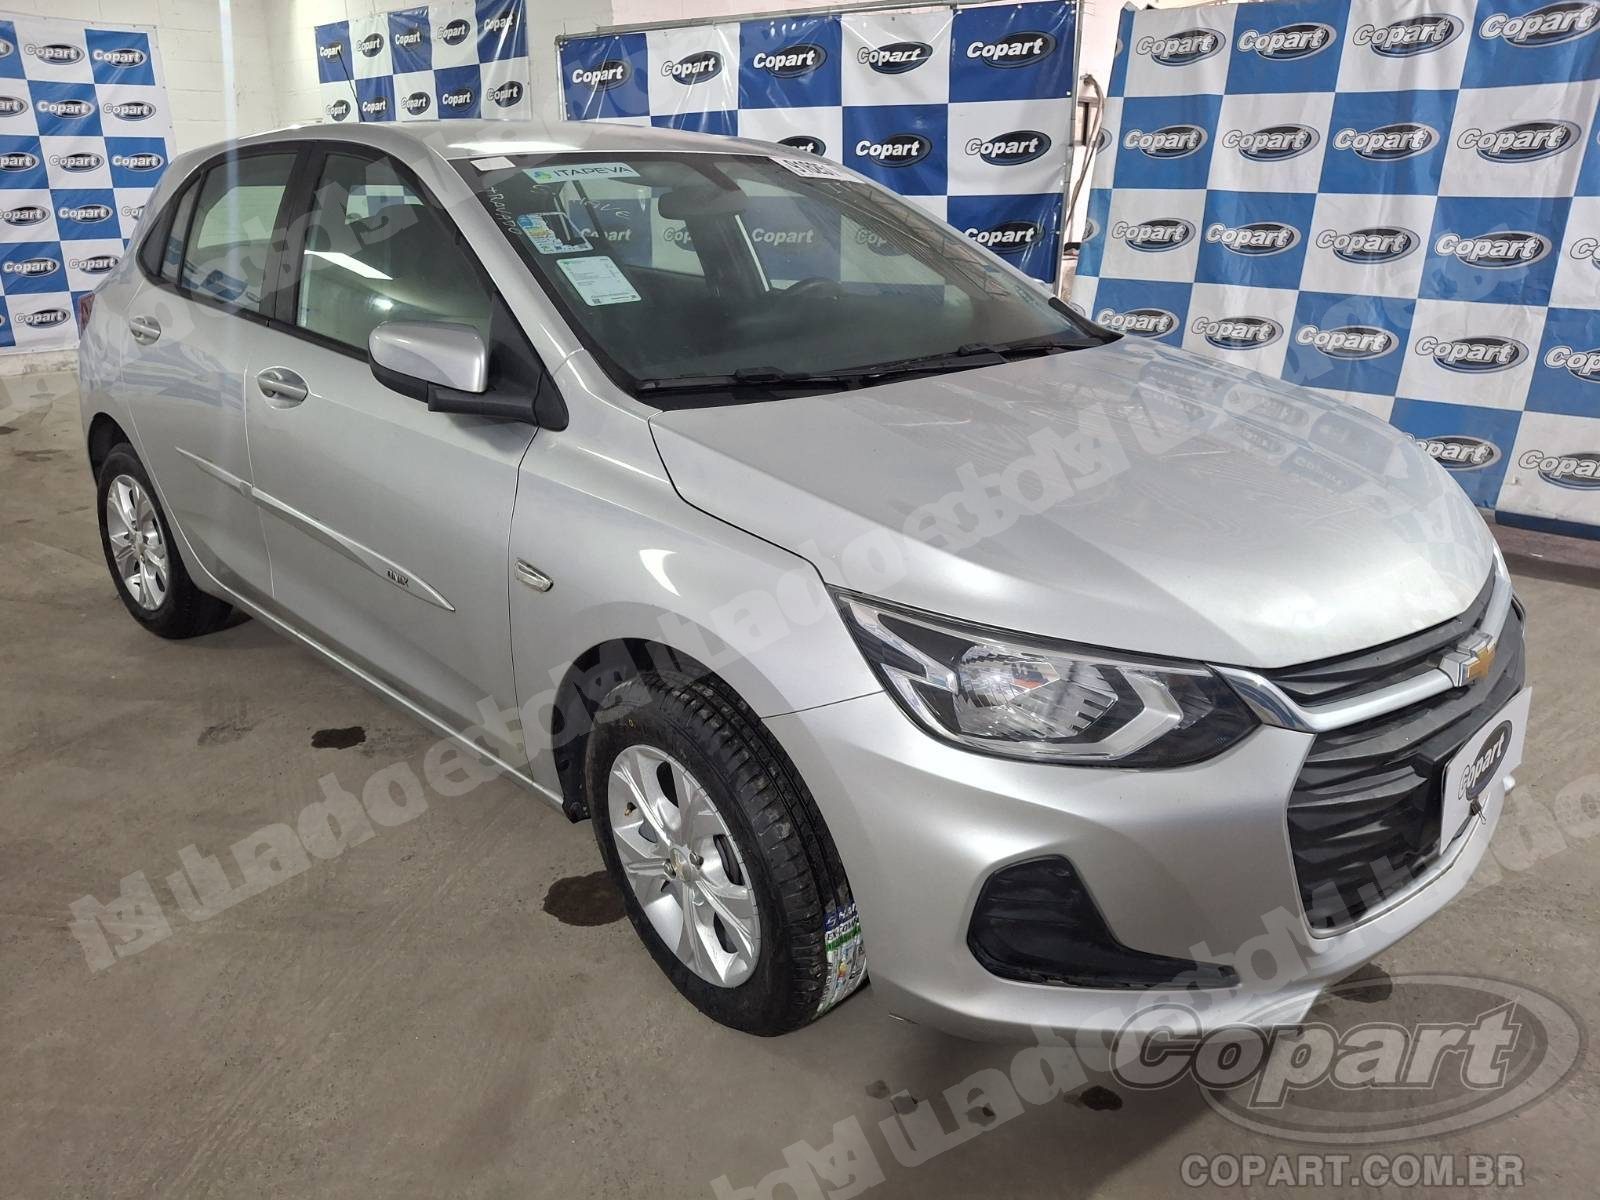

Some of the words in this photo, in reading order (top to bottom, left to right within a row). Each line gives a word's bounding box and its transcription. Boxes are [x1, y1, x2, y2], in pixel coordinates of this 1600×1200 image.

[437, 22, 466, 41] Copart
[1353, 18, 1450, 49] Copart
[1479, 3, 1598, 44] Copart
[356, 38, 381, 53] Copart
[395, 31, 421, 46] Copart
[967, 37, 1044, 60] Copart
[1136, 32, 1216, 60] Copart
[1238, 24, 1329, 55] Copart
[24, 44, 78, 60] Copart
[93, 50, 141, 64] Copart
[320, 44, 342, 58] Copart
[753, 49, 815, 70] Copart
[857, 45, 922, 66] Copart
[572, 65, 624, 85] Copart
[661, 57, 716, 78] Copart
[401, 95, 427, 110] Copart
[442, 91, 471, 106] Copart
[487, 85, 518, 102] Copart
[37, 101, 88, 116] Copart
[103, 103, 150, 116] Copart
[362, 99, 386, 113] Copart
[965, 137, 1039, 157] Copart
[1124, 128, 1199, 153] Copart
[1222, 128, 1309, 154] Copart
[1333, 127, 1428, 154] Copart
[1458, 123, 1568, 153] Copart
[855, 140, 920, 159] Copart
[0, 155, 33, 169] part
[50, 152, 97, 168] Copart
[112, 155, 158, 169] Copart
[554, 165, 634, 178] ITAPEVA
[58, 207, 107, 220] Copart
[752, 228, 814, 246] Copart
[963, 227, 1035, 247] Copart
[1112, 220, 1187, 243] Copart
[1206, 222, 1291, 248] Copart
[1316, 229, 1408, 253] Copart
[1435, 233, 1540, 261] Copart
[3, 260, 53, 273] Copart
[69, 257, 116, 271] Copart
[15, 310, 64, 324] Copart
[1096, 308, 1171, 333] Copart
[1191, 316, 1273, 341] Copart
[1296, 324, 1387, 353] Copart
[1415, 336, 1516, 364] Copart
[1519, 450, 1600, 478] Copa
[1458, 730, 1505, 801] Copart
